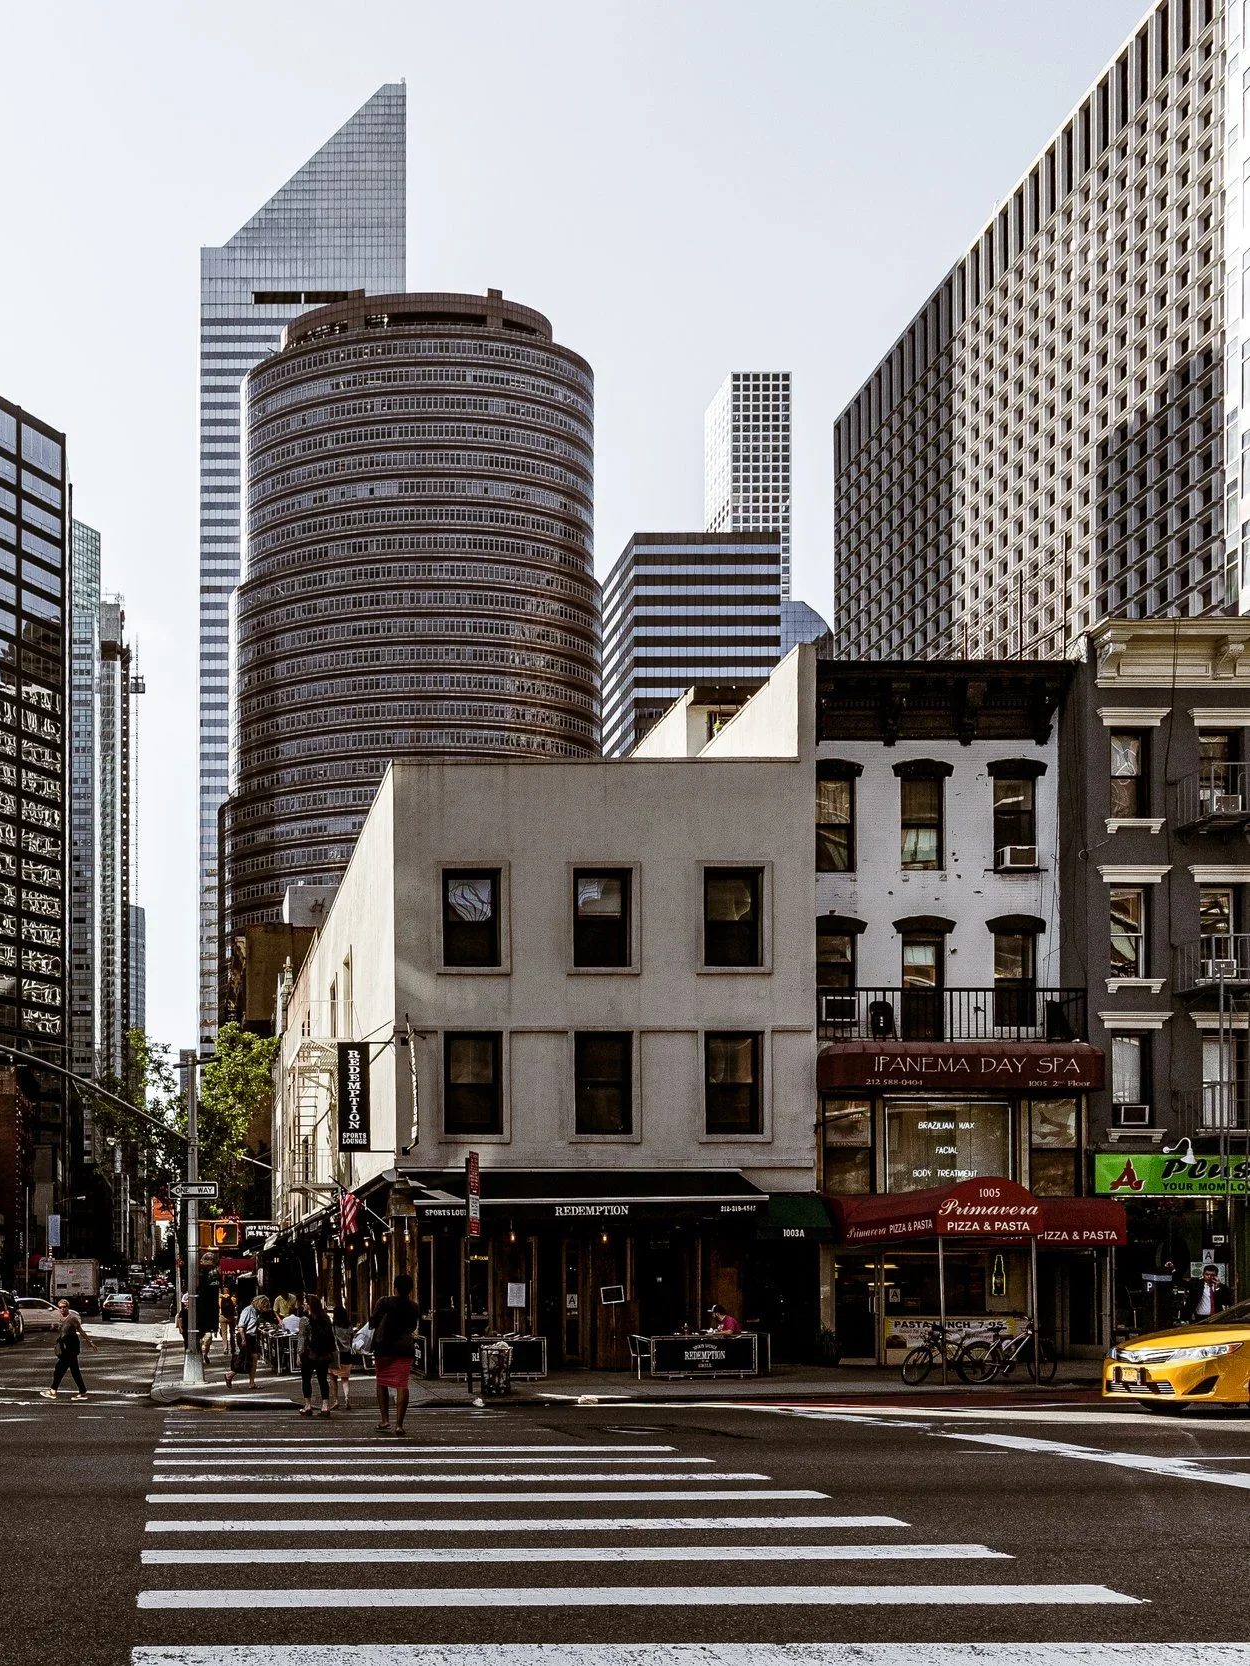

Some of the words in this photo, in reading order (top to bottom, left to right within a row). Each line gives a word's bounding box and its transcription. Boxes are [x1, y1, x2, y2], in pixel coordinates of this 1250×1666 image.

[874, 1056, 970, 1073] IPANEMA
[981, 1057, 1027, 1073] DAY
[1036, 1057, 1080, 1073] SPA
[1068, 1079, 1090, 1087] Floor
[347, 1050, 361, 1129] REDEMPTION
[918, 1121, 955, 1129] BRAZILIAN
[935, 1146, 959, 1154] FACIAL
[912, 1169, 932, 1177] BODY
[937, 1169, 978, 1178] TREATMENT
[198, 1186, 212, 1194] WAY
[1162, 1182, 1193, 1191] YOUR
[1198, 1182, 1225, 1191] MOM
[979, 1188, 1001, 1198] 1005
[554, 1205, 630, 1216] REDEMPTION
[938, 1198, 1039, 1216] Primavera
[889, 1223, 907, 1234] PIZZA
[907, 1222, 912, 1231] &
[913, 1219, 933, 1231] PASTA
[947, 1222, 980, 1230] PIZZA
[983, 1222, 991, 1230] &
[995, 1222, 1031, 1230] PASTA
[783, 1229, 805, 1237] 1003A
[1072, 1231, 1080, 1240] &
[1083, 1231, 1118, 1240] PASTA
[894, 1321, 929, 1329] PASTA
[684, 1350, 726, 1361] REDEMPTION
